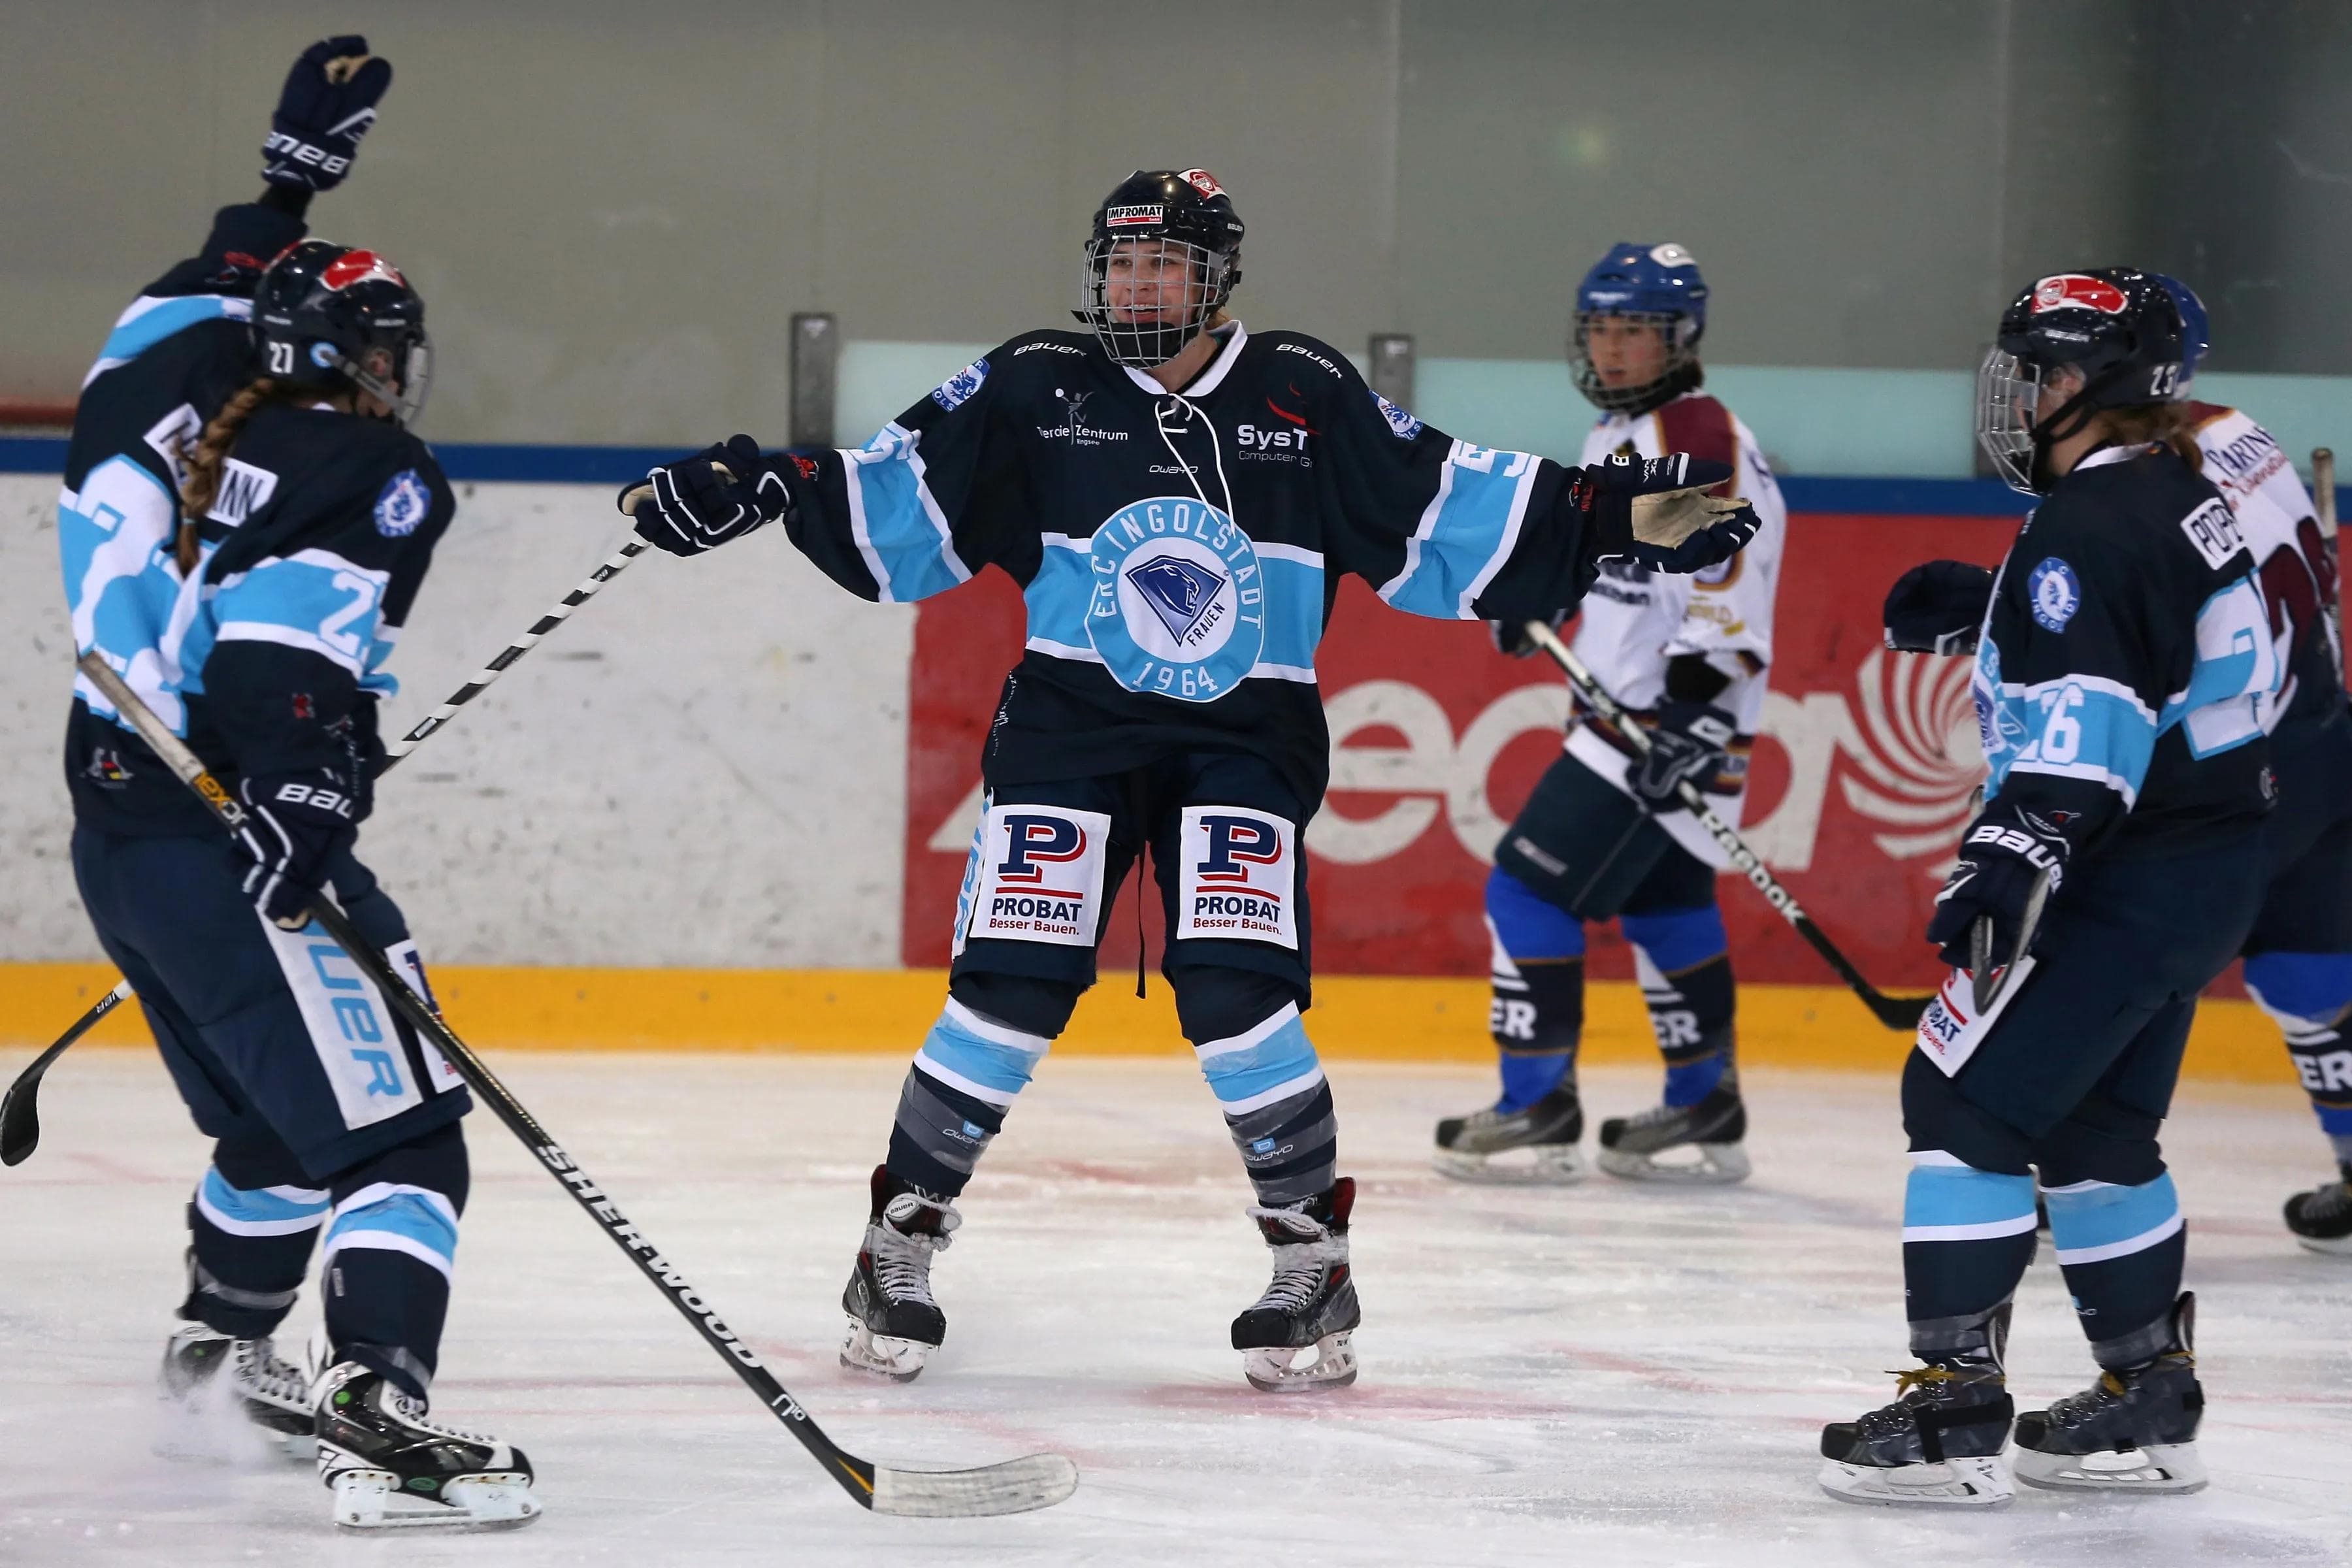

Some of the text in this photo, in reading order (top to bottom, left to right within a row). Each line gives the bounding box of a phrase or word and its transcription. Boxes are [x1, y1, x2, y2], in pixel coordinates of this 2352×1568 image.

[1108, 206, 1162, 219] IMPROMAT
[1075, 425, 1128, 440] Zentrum
[1237, 425, 1308, 450] SysT
[1239, 451, 1297, 463] Computer
[1104, 503, 1262, 629] INGOLSTADT
[319, 568, 379, 660] 2
[1187, 601, 1226, 647] FRAUEN
[1132, 661, 1218, 696] 1964
[998, 814, 1086, 883] P
[1197, 815, 1282, 883] P
[988, 917, 1080, 936] Besser Bauen.
[991, 897, 1082, 923] PROBAT
[1193, 917, 1282, 936] Besser Bauen.
[1194, 896, 1281, 923] PROBAT
[1490, 997, 1536, 1041] ER
[1650, 1010, 1701, 1049] ER
[537, 1145, 763, 1369] SHER-WOOD
